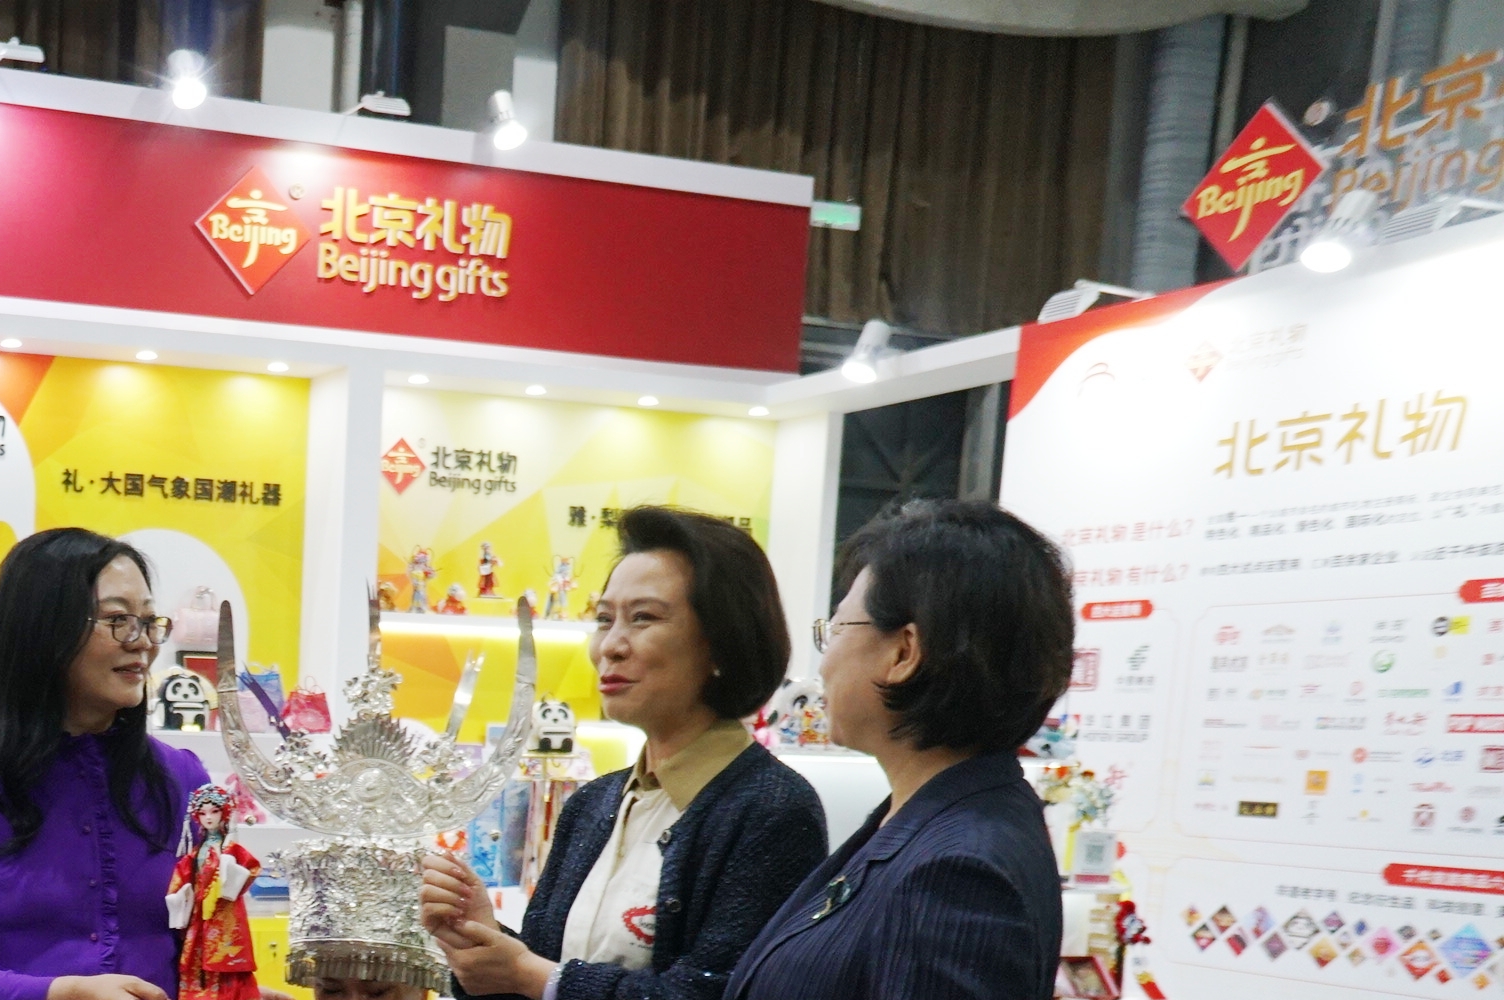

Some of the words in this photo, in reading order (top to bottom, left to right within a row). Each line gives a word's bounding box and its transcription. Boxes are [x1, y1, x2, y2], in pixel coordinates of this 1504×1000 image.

[319, 186, 512, 259] 北京礼物
[1196, 168, 1305, 243] Beijing
[208, 213, 298, 268] Beijing
[317, 242, 434, 300] Beijing
[435, 258, 509, 302] gifts
[430, 446, 518, 475] 北京礼物
[1212, 389, 1468, 480] 北京礼物
[429, 470, 481, 495] Beijing
[484, 476, 517, 496] gifts
